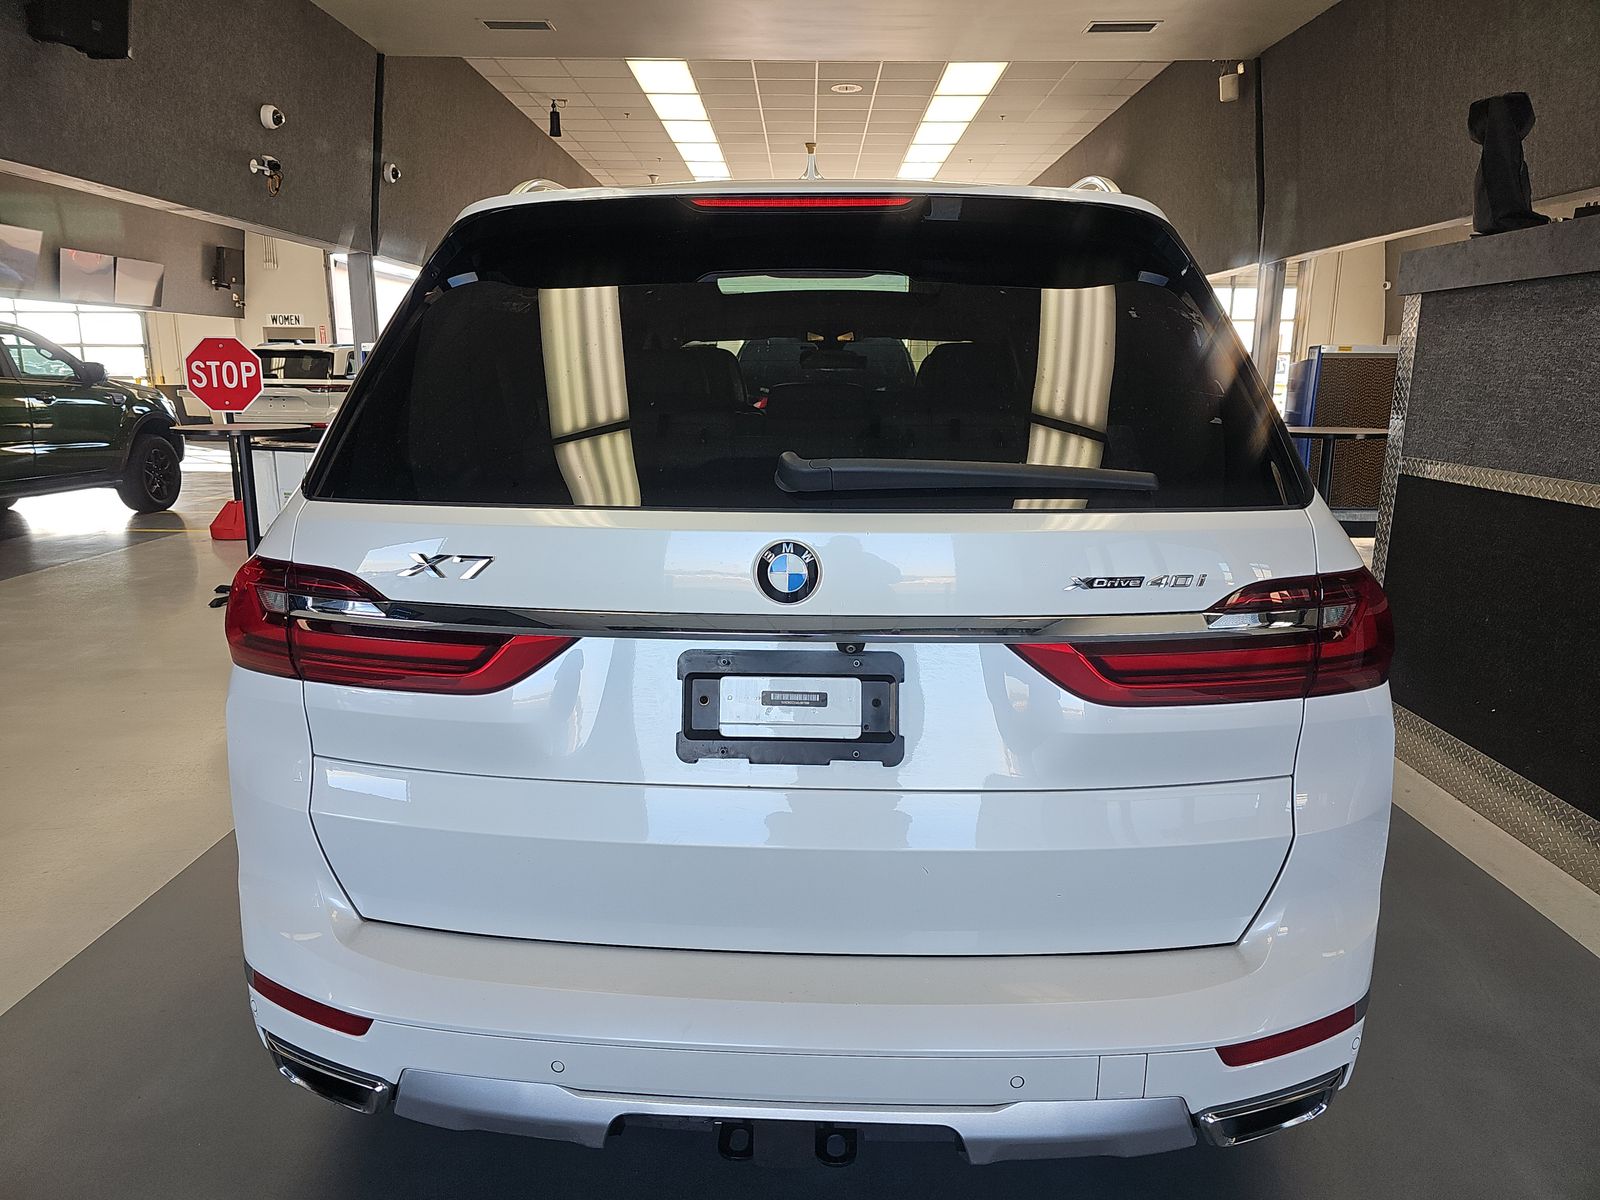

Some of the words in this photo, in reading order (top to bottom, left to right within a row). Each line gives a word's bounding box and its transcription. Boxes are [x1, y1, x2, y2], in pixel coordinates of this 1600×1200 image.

[270, 314, 301, 326] WOMEN
[191, 360, 257, 389] STOP
[762, 542, 815, 563] BMW
[397, 552, 495, 580] X7
